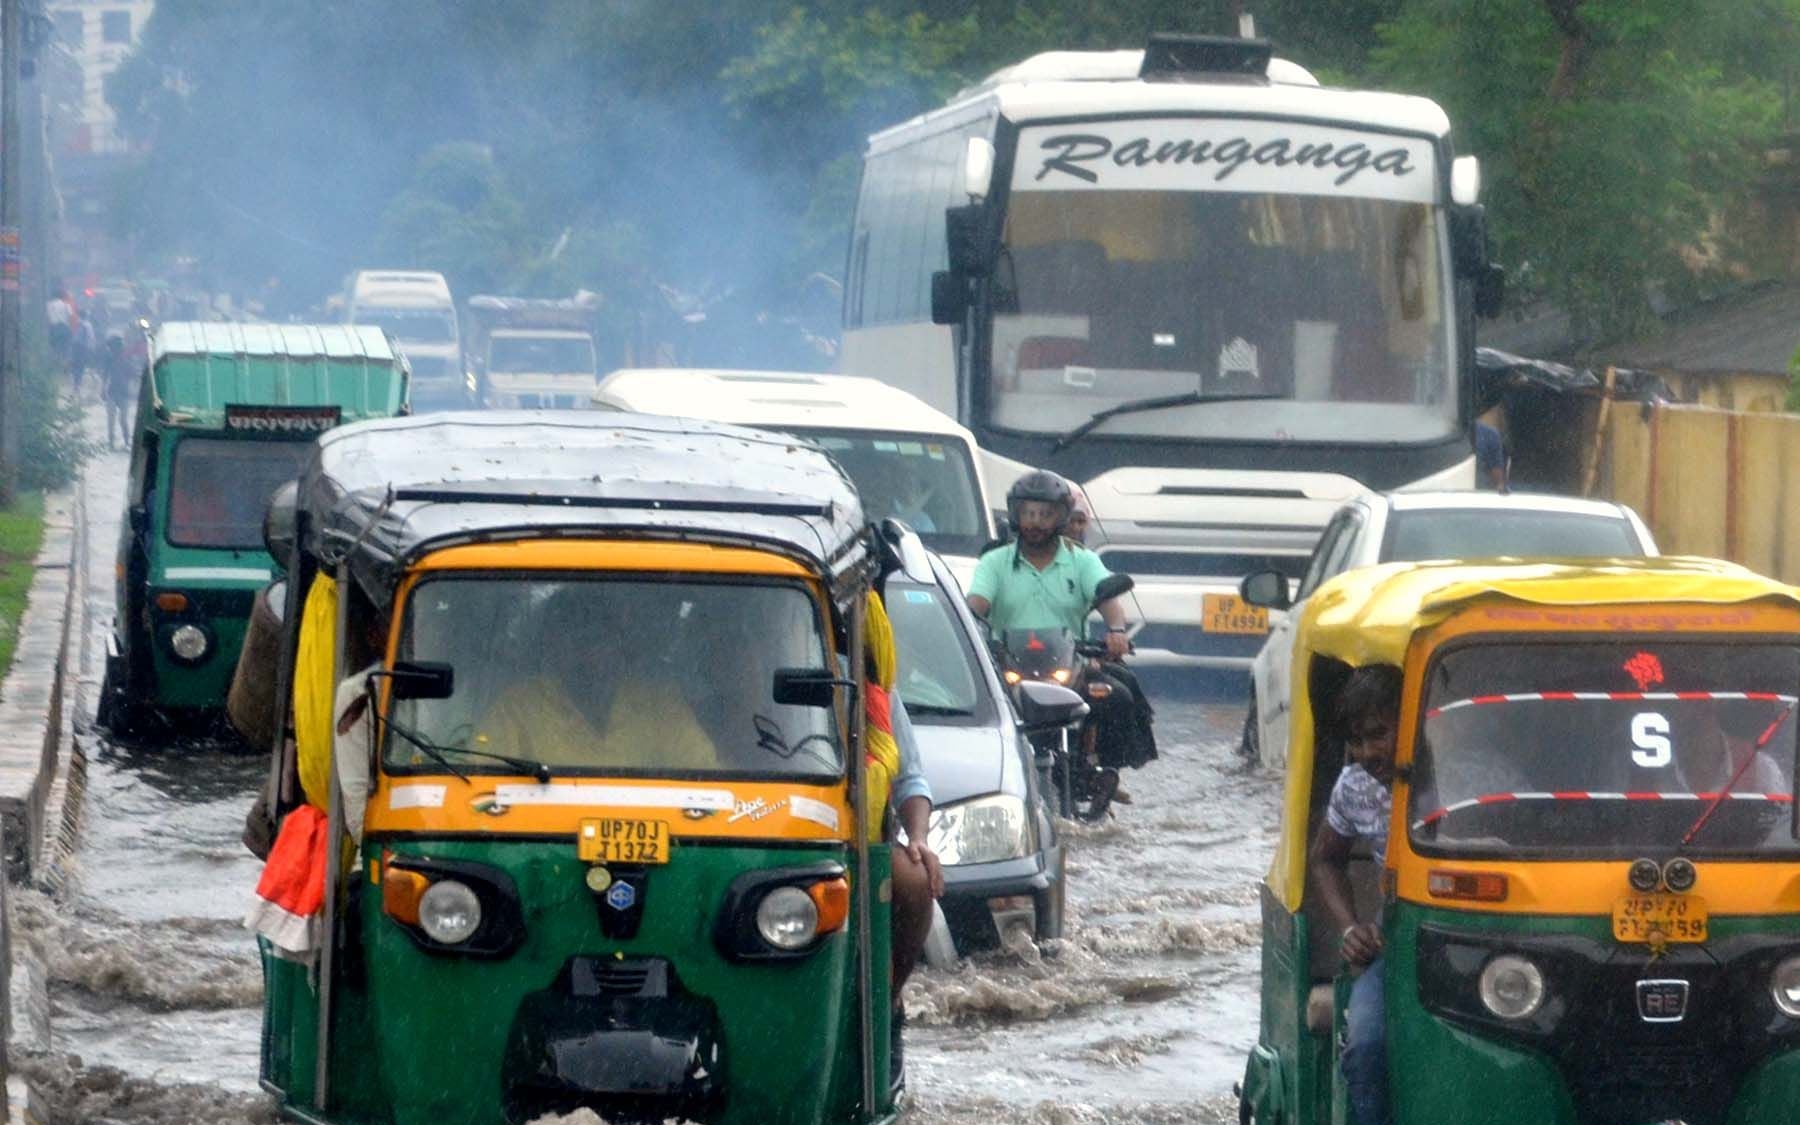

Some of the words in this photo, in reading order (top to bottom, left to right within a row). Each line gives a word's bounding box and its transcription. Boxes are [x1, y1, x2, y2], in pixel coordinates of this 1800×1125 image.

[1035, 132, 1415, 187] Ramganga
[1631, 711, 1672, 768] S
[600, 819, 660, 841] UP70J
